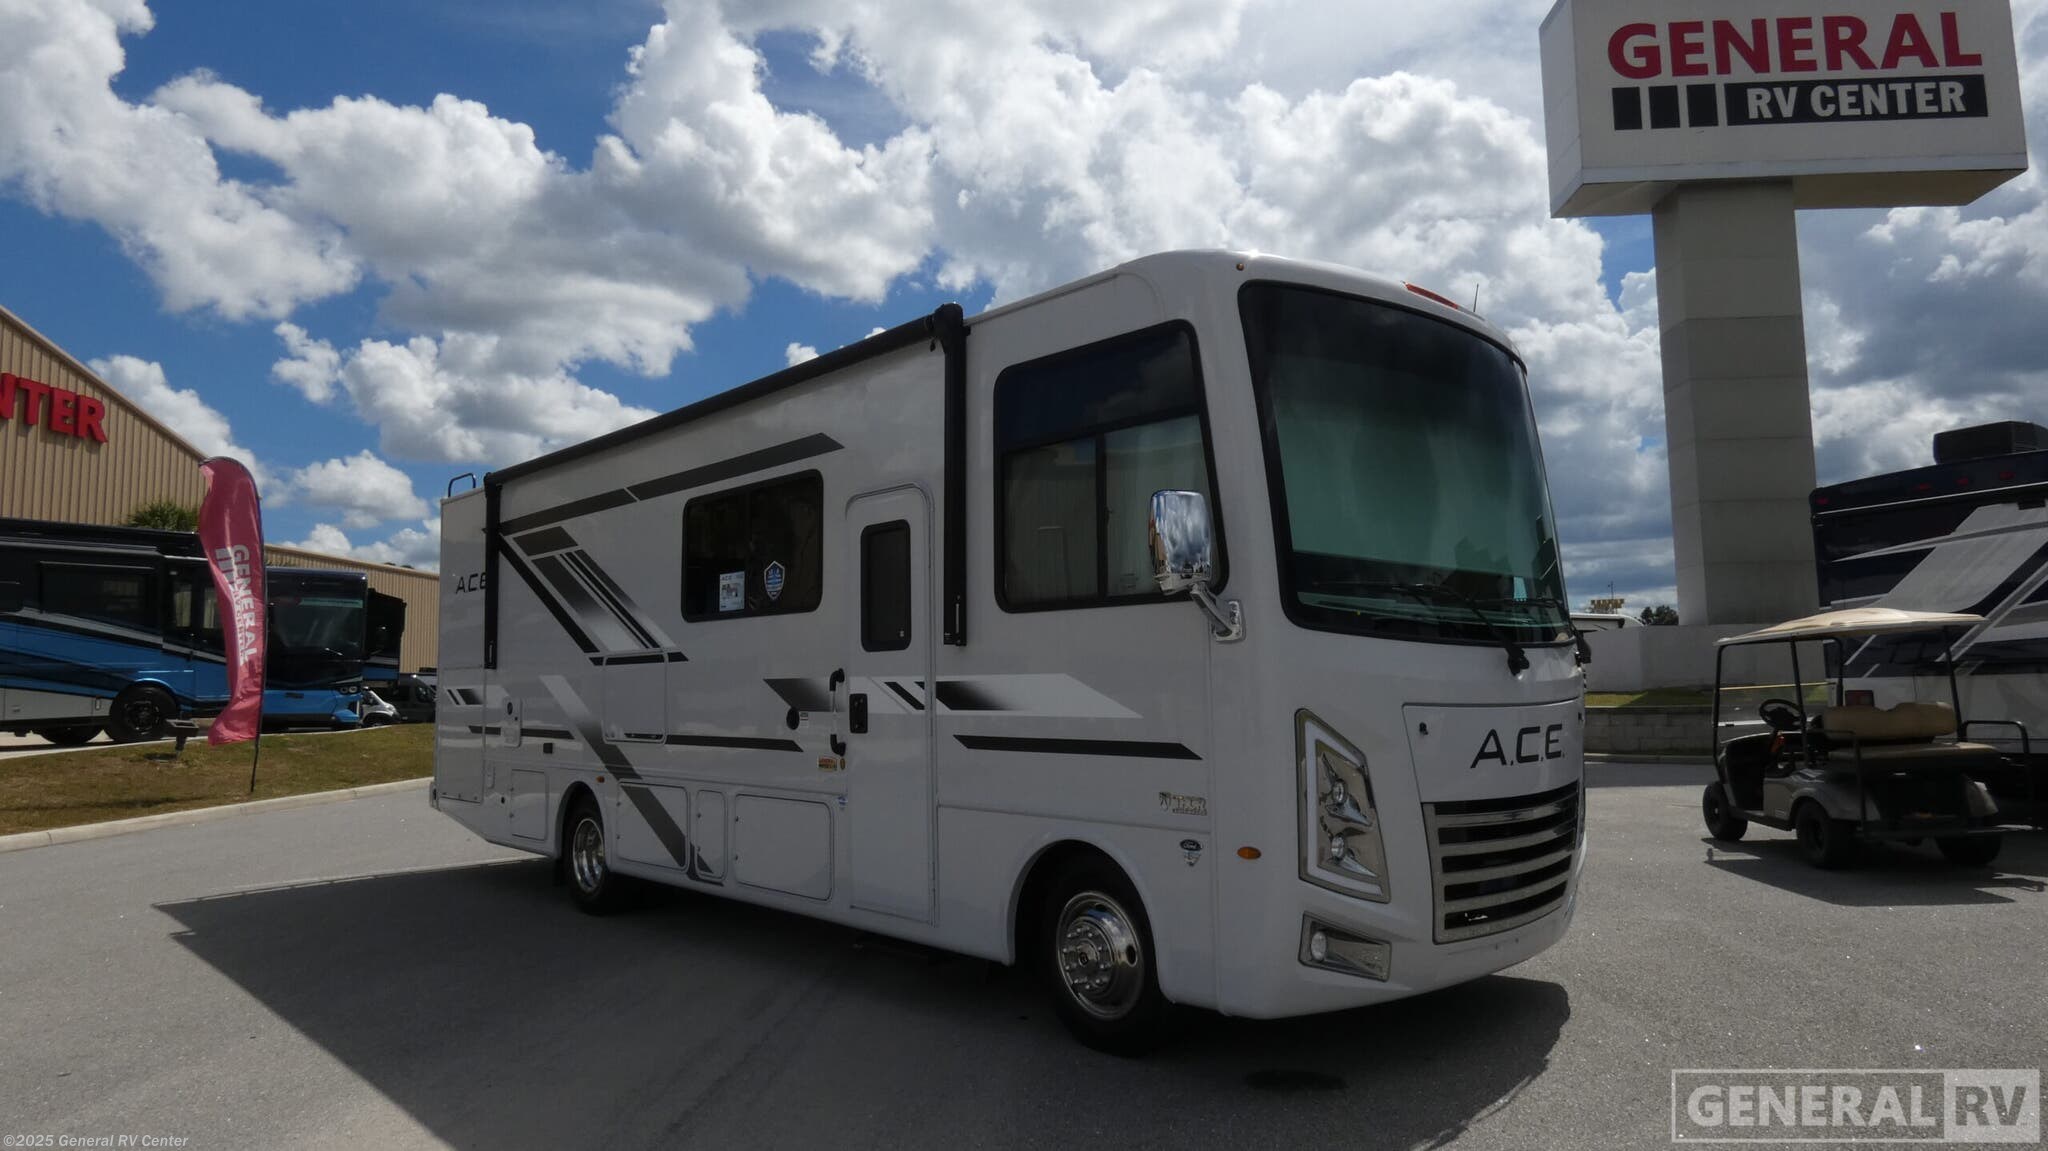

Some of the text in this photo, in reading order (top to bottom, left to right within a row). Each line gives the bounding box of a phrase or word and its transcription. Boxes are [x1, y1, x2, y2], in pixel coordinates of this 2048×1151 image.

[1607, 12, 1983, 80] GENERAL
[1746, 82, 1966, 120] RV CENTER
[231, 544, 257, 662] GENERAL
